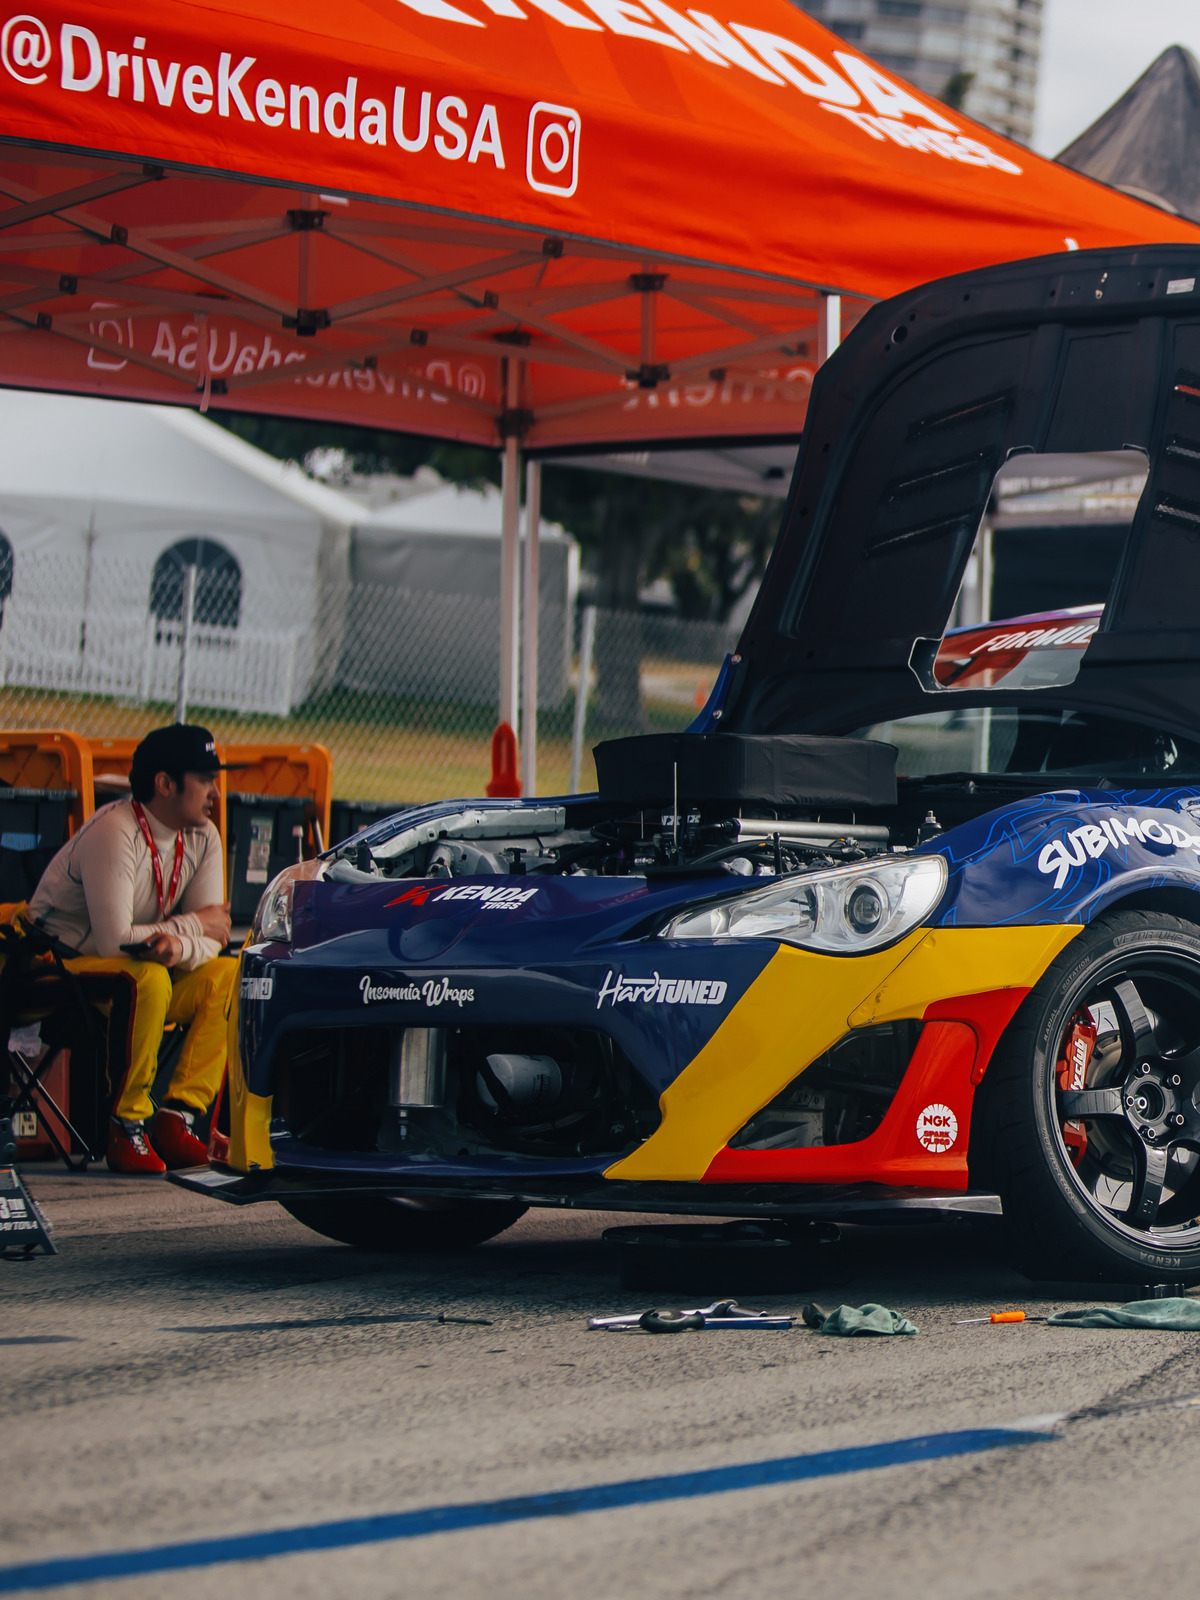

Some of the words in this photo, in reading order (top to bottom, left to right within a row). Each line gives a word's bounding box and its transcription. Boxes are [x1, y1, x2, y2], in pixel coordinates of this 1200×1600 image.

[1, 15, 505, 169] @DriveKendaUSA
[432, 886, 539, 902] KENDA
[480, 902, 522, 910] TIRES
[359, 975, 421, 1004] Insomnia
[422, 977, 475, 1007] Wraps
[923, 1115, 951, 1127] NGK
[0, 1221, 38, 1231] AYTONA
[1140, 1252, 1181, 1266] KENDA
